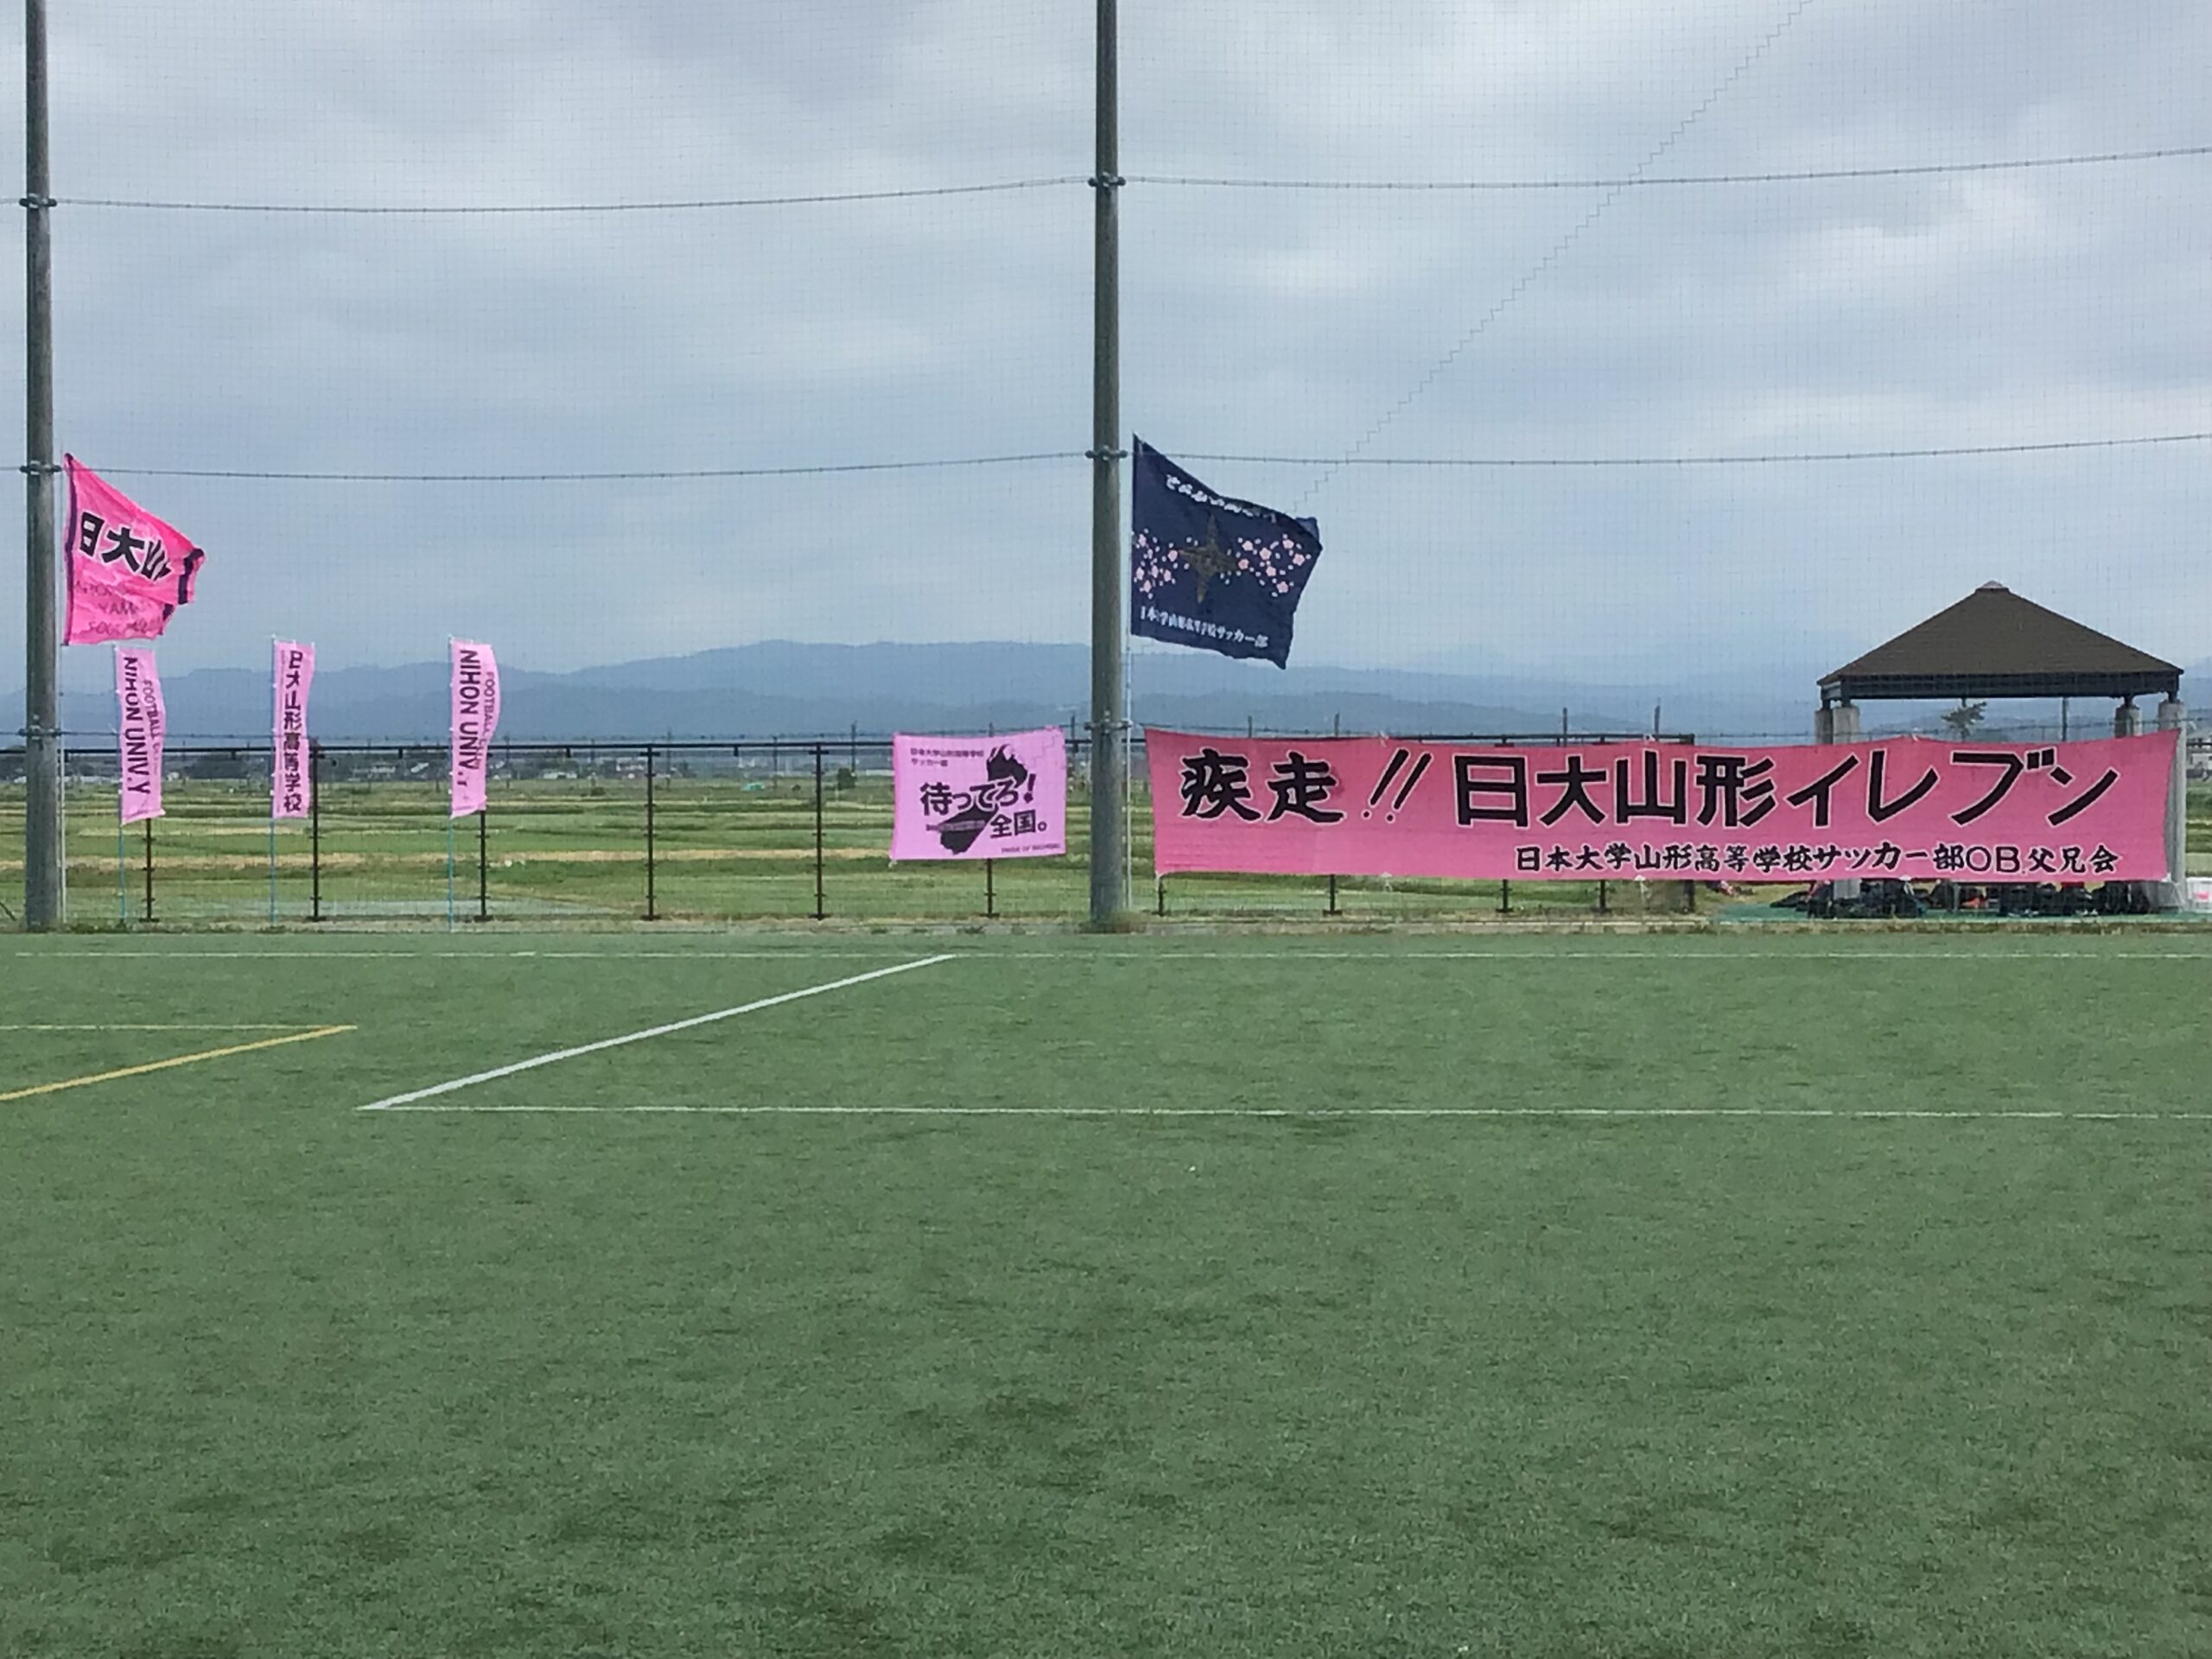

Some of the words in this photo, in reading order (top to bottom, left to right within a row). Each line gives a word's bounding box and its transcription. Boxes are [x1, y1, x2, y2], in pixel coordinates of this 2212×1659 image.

[123, 656, 143, 721] NIHON
[143, 679, 162, 740] FOOTBALL
[459, 649, 481, 715] NIHON
[482, 671, 496, 737] FOOTBALL
[1452, 747, 2120, 828] 日大山形イレブン
